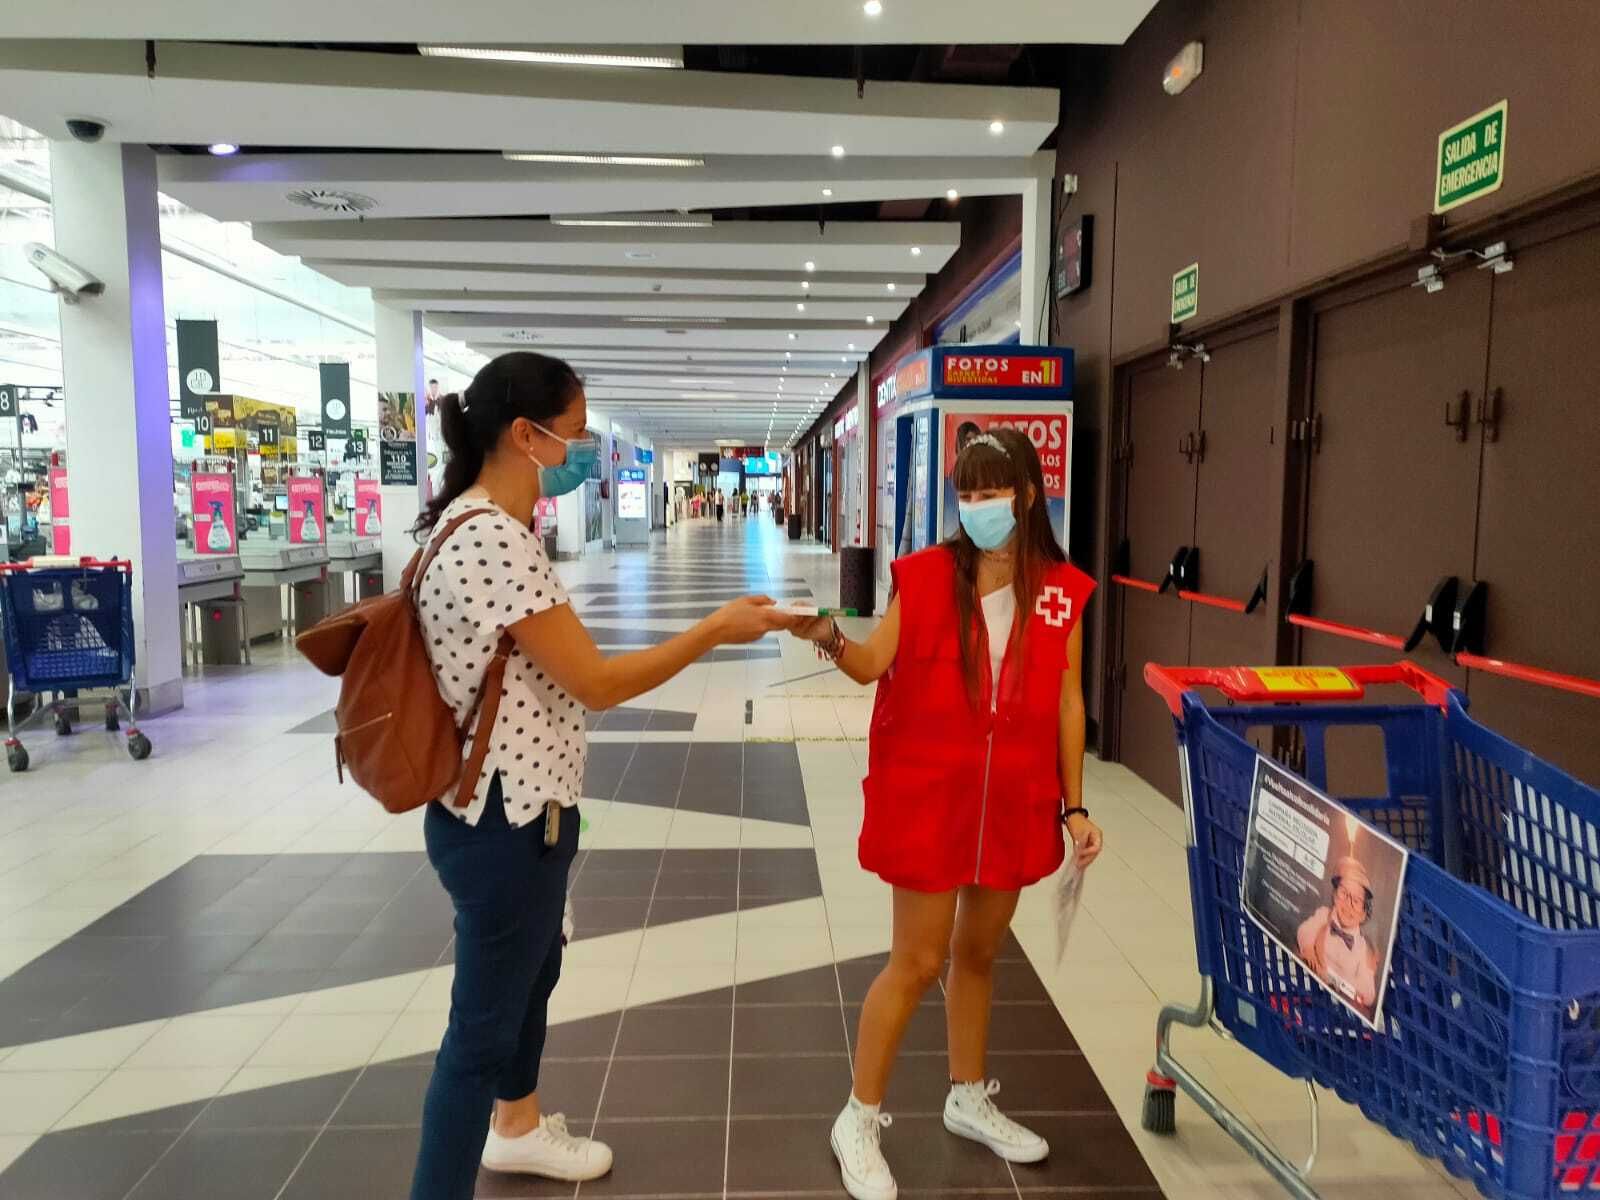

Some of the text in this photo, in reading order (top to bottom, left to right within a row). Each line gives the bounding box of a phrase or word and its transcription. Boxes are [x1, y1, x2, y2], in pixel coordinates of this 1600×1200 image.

[1445, 120, 1498, 166] SALIDA DE
[1441, 151, 1498, 197] EMERGENCIA
[947, 358, 1009, 372] FOTOS
[1022, 370, 1041, 384] EN
[1040, 360, 1051, 385] 1
[947, 376, 998, 385] DIVERTIDAS
[0, 391, 10, 411] 8
[195, 415, 209, 432] 10
[262, 428, 273, 442] 11
[310, 435, 323, 449] 12
[351, 440, 364, 453] 13
[391, 454, 407, 463] 110
